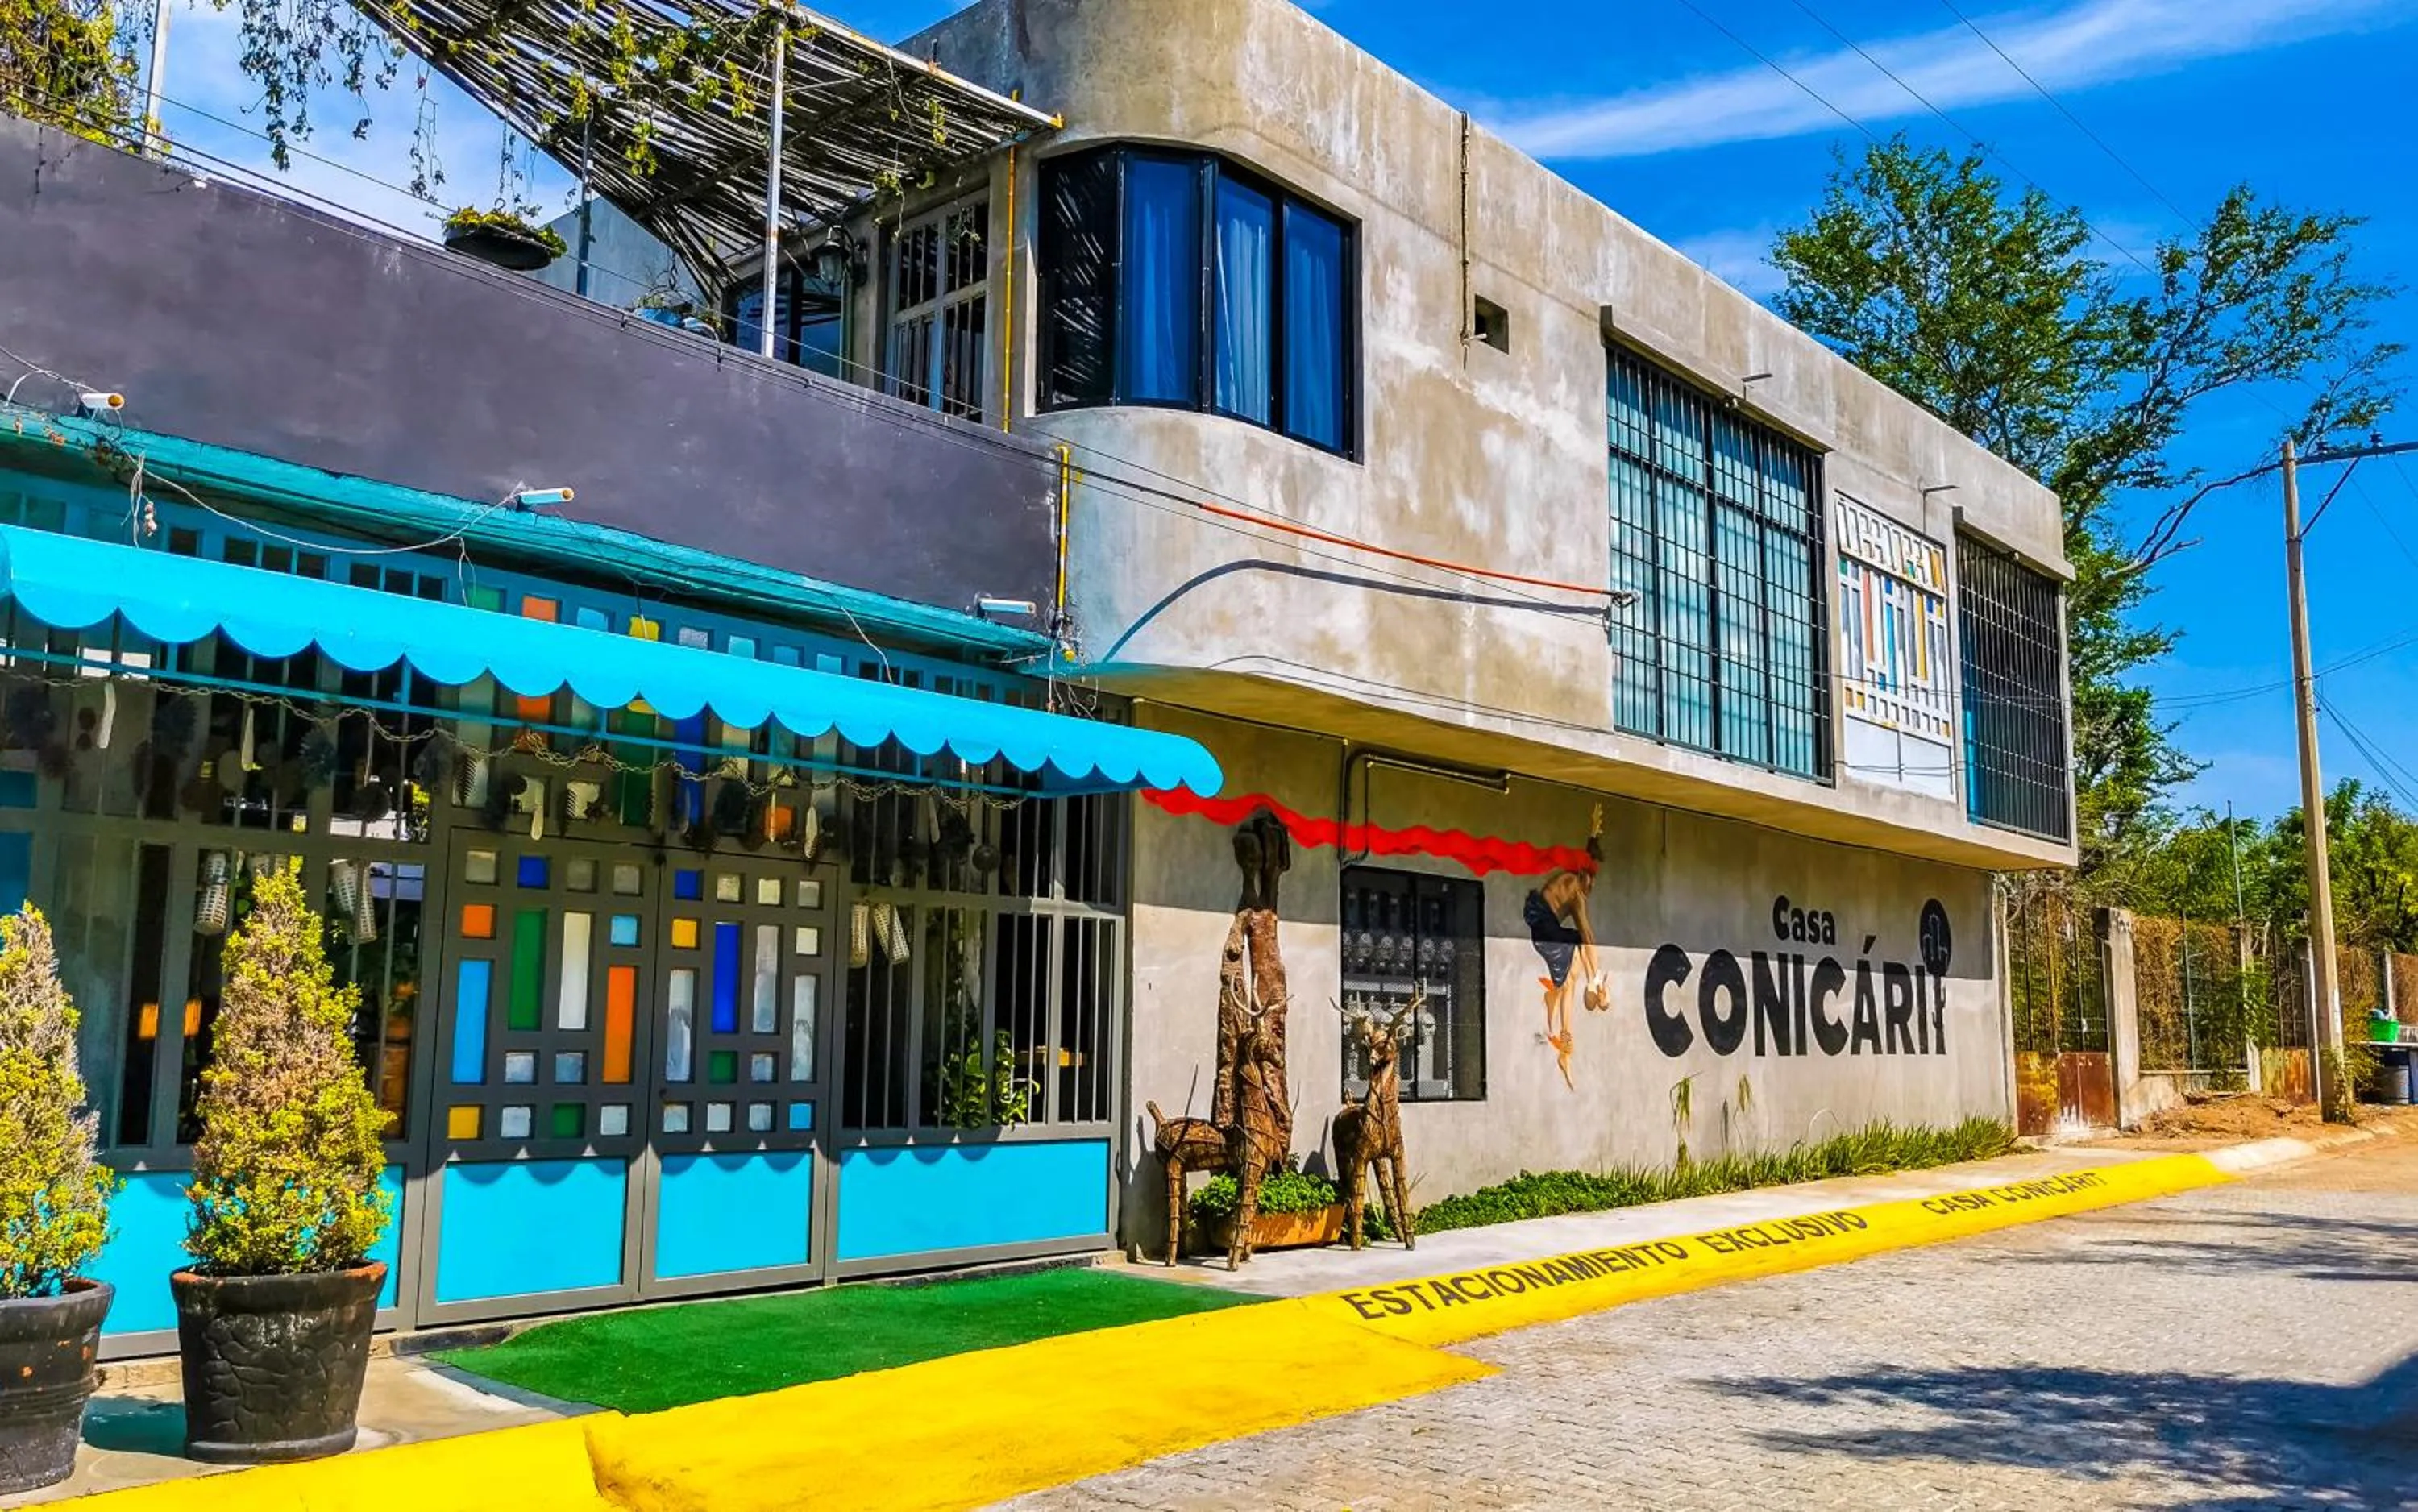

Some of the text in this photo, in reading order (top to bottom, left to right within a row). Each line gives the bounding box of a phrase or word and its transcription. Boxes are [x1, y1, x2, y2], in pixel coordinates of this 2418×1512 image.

[1773, 895, 1836, 945] Casa
[1340, 1240, 1689, 1320] ESTACIONAMIENTO
[1697, 1211, 1868, 1253] EXCLUSIVO
[1921, 1193, 1997, 1215] CASA
